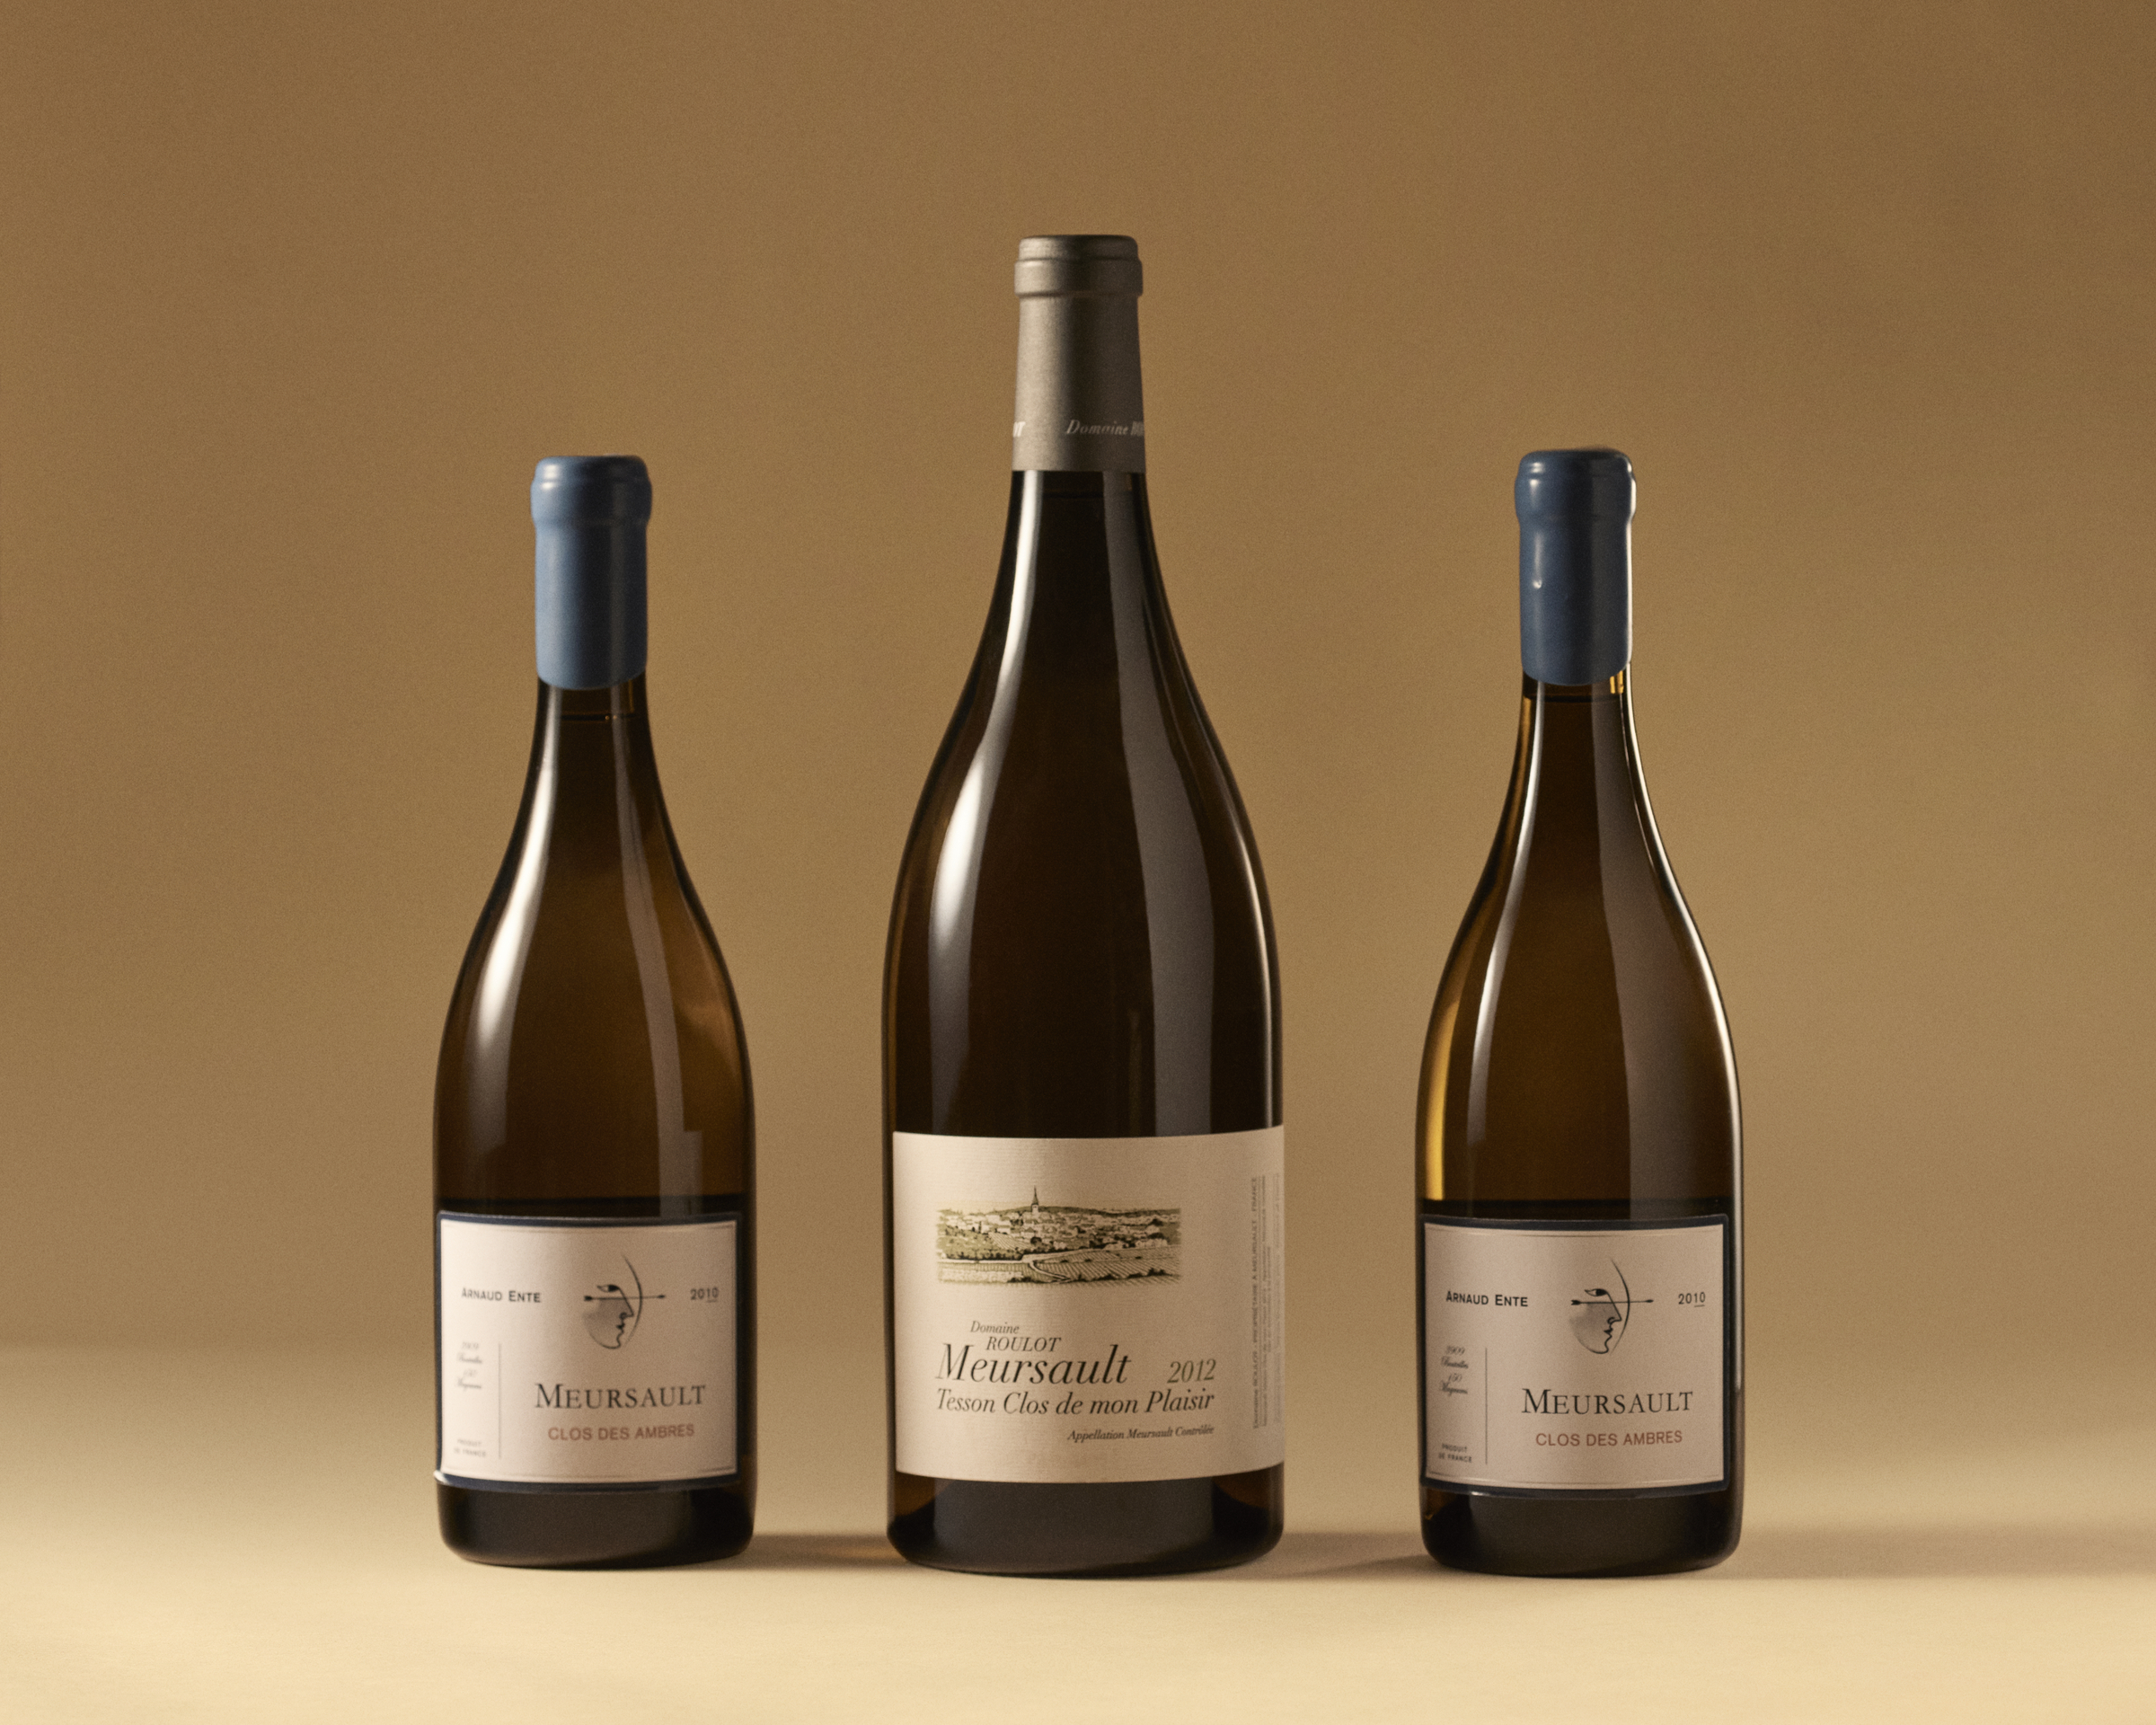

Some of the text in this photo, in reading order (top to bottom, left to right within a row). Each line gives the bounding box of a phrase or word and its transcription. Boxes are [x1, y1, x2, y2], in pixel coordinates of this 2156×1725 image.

[1066, 419, 1128, 435] Domaine
[462, 1287, 541, 1303] ARNAUD ENTE
[691, 1287, 719, 1300] 2010
[1446, 1291, 1528, 1306] ARNAUD ENTE
[1678, 1292, 1706, 1305] 2010
[970, 1321, 1020, 1334] Domaine
[985, 1336, 1062, 1352] ROULOT
[935, 1343, 1132, 1384] Meursault
[1167, 1359, 1216, 1384] 2012
[534, 1383, 705, 1409] MEURSAULT
[937, 1388, 1215, 1414] Tesson Clos de mon Plaisir
[1521, 1388, 1693, 1414] MEURSAULT
[548, 1423, 695, 1441] CLOS DES AMBRES
[1067, 1429, 1124, 1443] Appellation
[1127, 1428, 1173, 1439] Meursault
[1536, 1430, 1683, 1446] CLOS DES AMBRES
